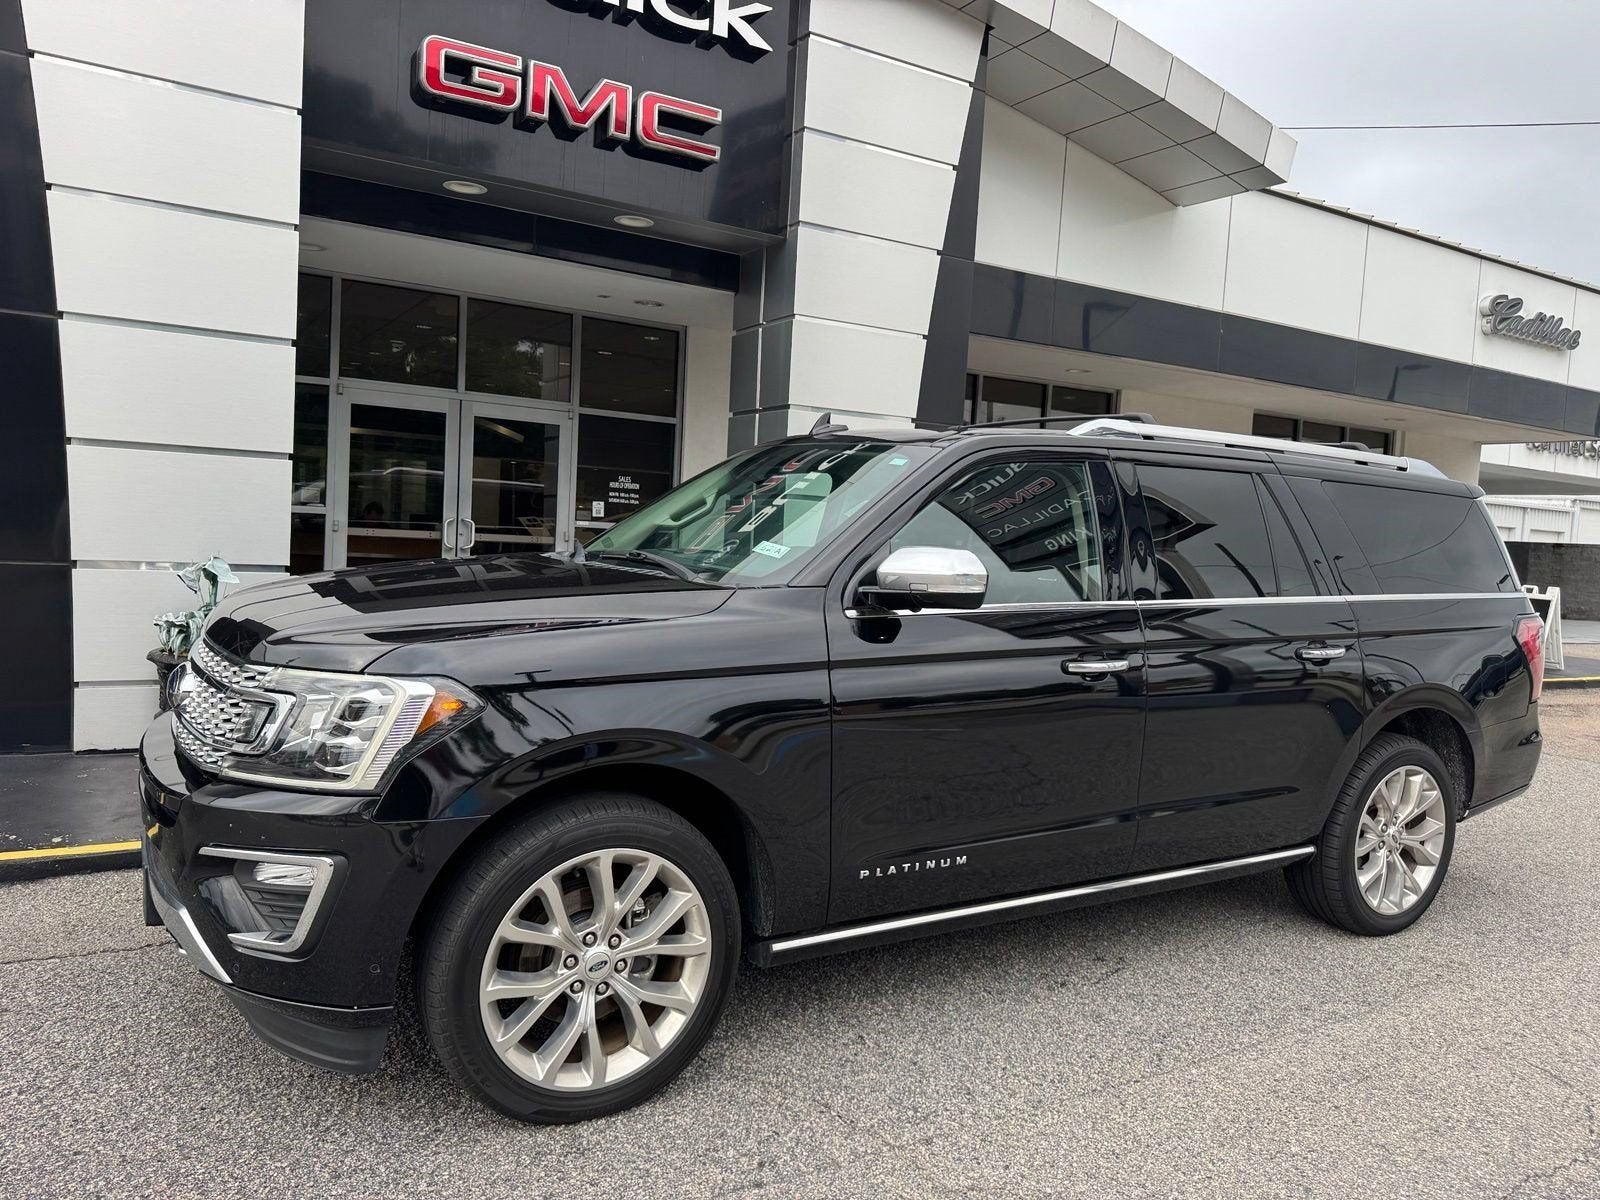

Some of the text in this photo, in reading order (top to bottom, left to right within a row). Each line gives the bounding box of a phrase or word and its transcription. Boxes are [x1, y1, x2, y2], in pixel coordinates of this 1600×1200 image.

[421, 35, 722, 163] GMC
[1484, 294, 1581, 350] Cadillac
[859, 855, 967, 879] PLATINUM
